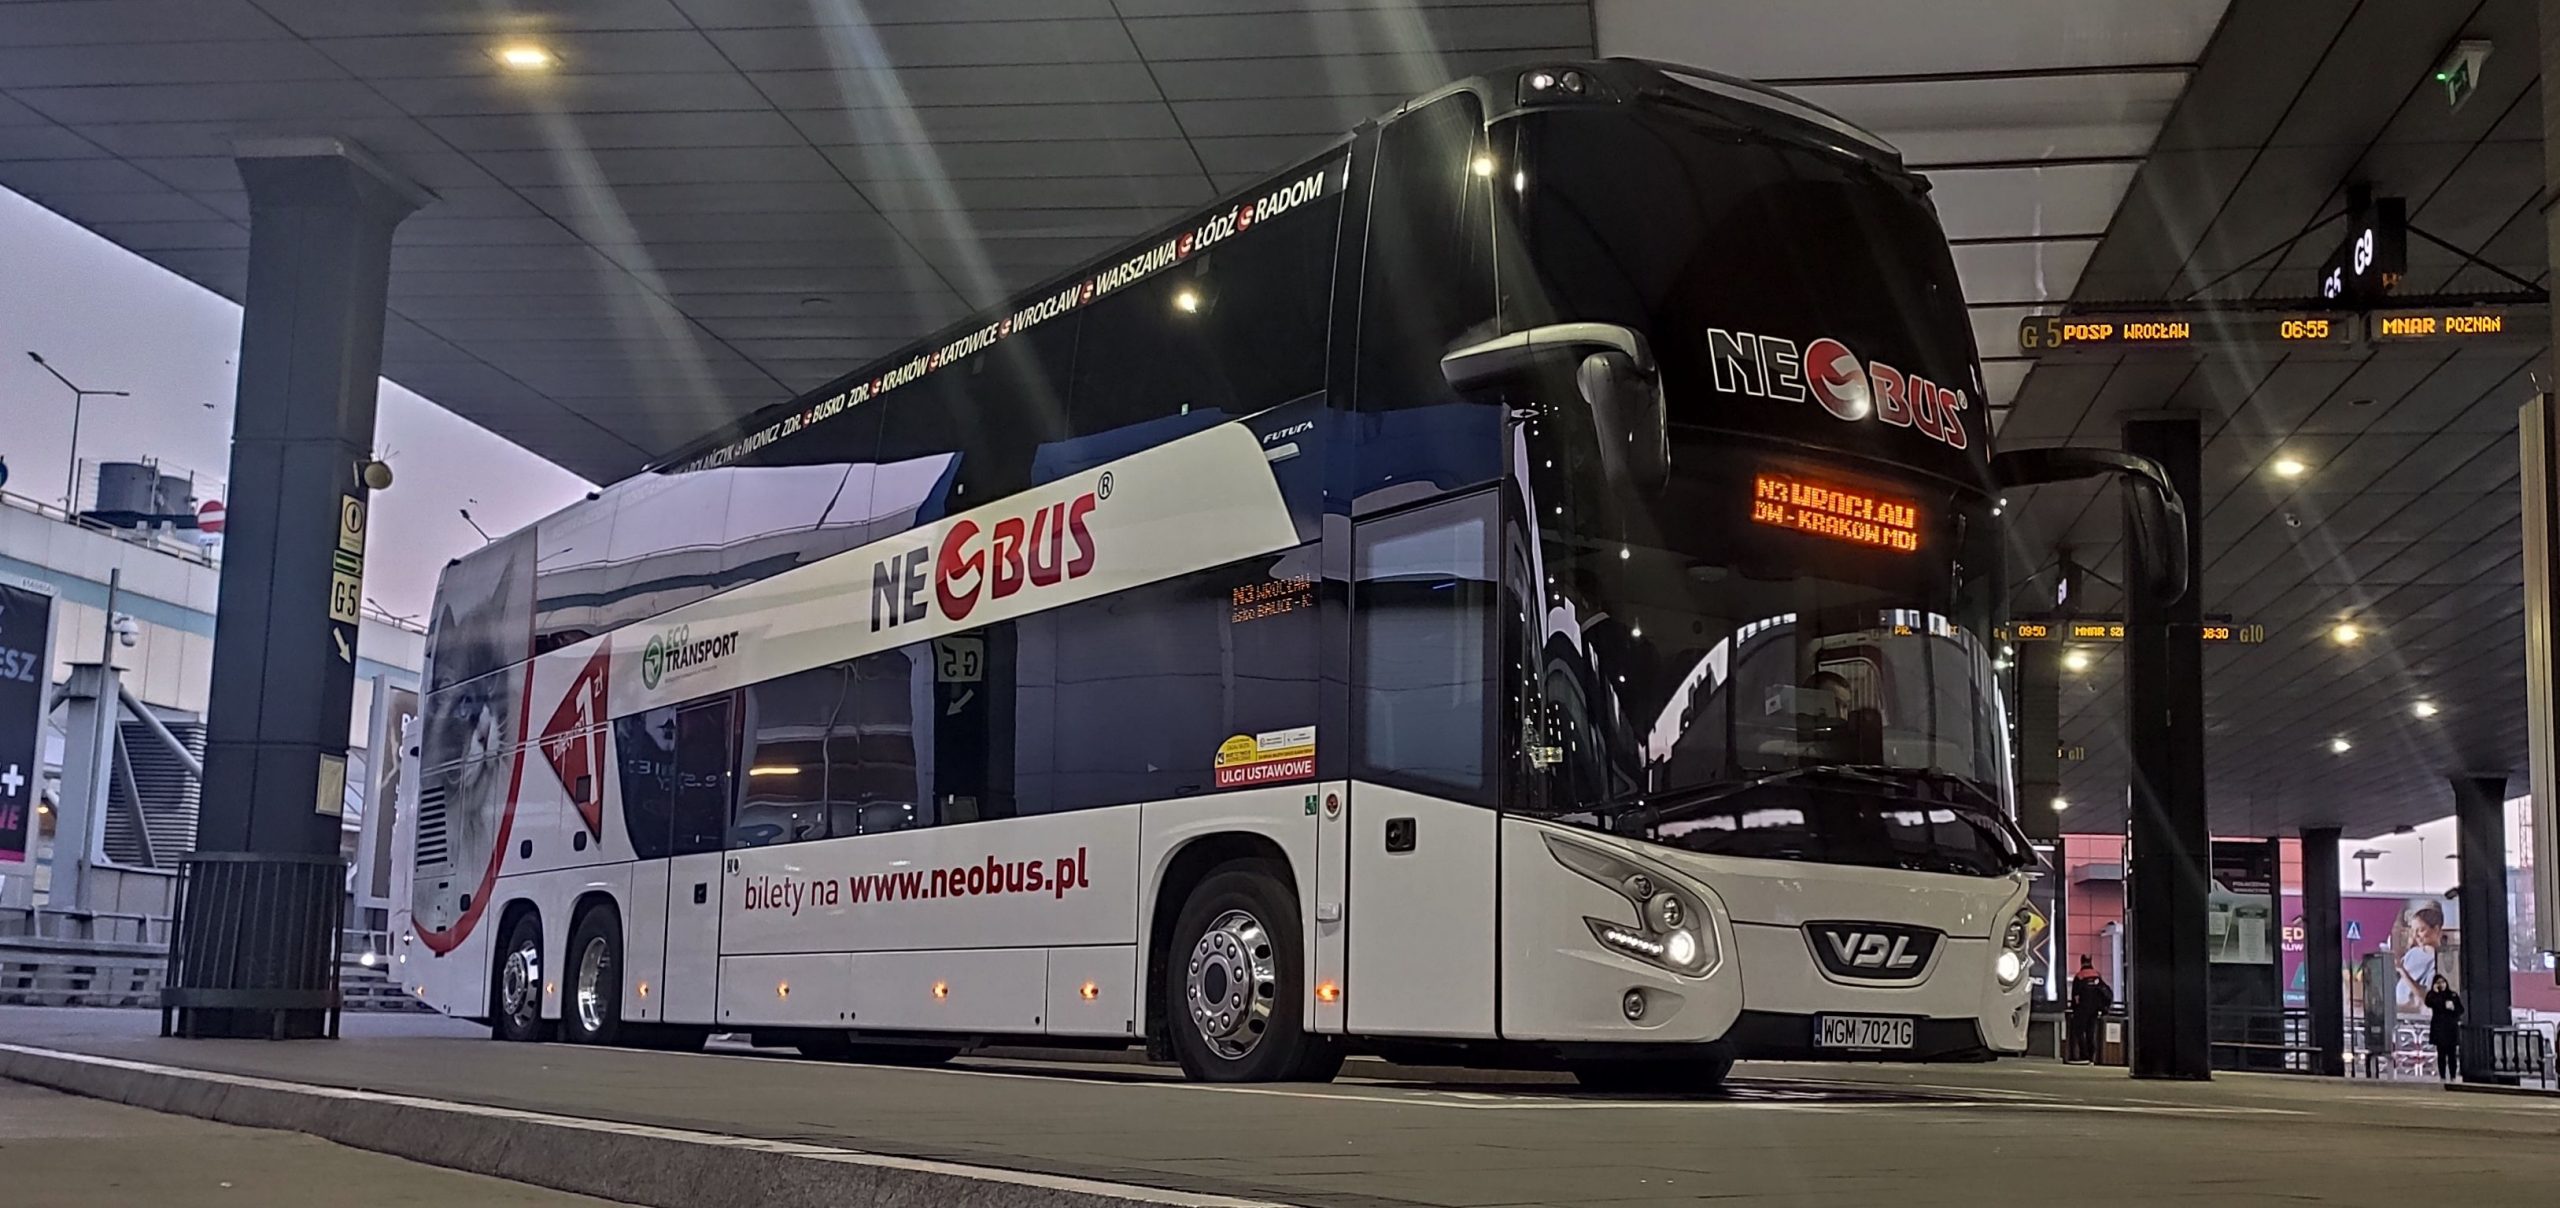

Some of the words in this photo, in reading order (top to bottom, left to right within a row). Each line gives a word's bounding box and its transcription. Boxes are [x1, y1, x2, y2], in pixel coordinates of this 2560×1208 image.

[2354, 228, 2373, 275] G9
[741, 423, 781, 456] IWONICZ
[781, 413, 801, 438] ZDR.
[812, 393, 845, 424] BUSKO
[847, 382, 870, 409] ZDR.
[881, 355, 930, 394] KRAKÓW
[939, 321, 1000, 368] KATOWICE
[1012, 284, 1082, 333] WROCŁAW
[1096, 239, 1177, 296] WARSZAWA
[1195, 204, 1239, 251] ŁÓDŹ
[1254, 171, 1324, 224] RADOM
[2382, 318, 2436, 335] MNAR
[2446, 316, 2501, 333] POZNAŃ
[2064, 324, 2113, 341] POSP
[2123, 323, 2190, 340] WROCŁAW
[2280, 320, 2329, 339] 06:55
[1263, 420, 1314, 443] FUTURA
[1798, 510, 1880, 544] KRAKÓW
[335, 580, 357, 617] G5
[666, 623, 690, 649] ECO
[2239, 624, 2264, 643] G10
[665, 631, 740, 673] TRANSPORT
[1221, 768, 1245, 783] ULGI
[1247, 760, 1312, 780] USTAWOWE
[744, 875, 805, 917] bilety
[811, 877, 839, 907] na
[849, 846, 1090, 903] www.neobus.pl
[1826, 931, 1919, 969] VDL
[1824, 1019, 1856, 1043] WGM
[1861, 1020, 1912, 1044] 7021G
